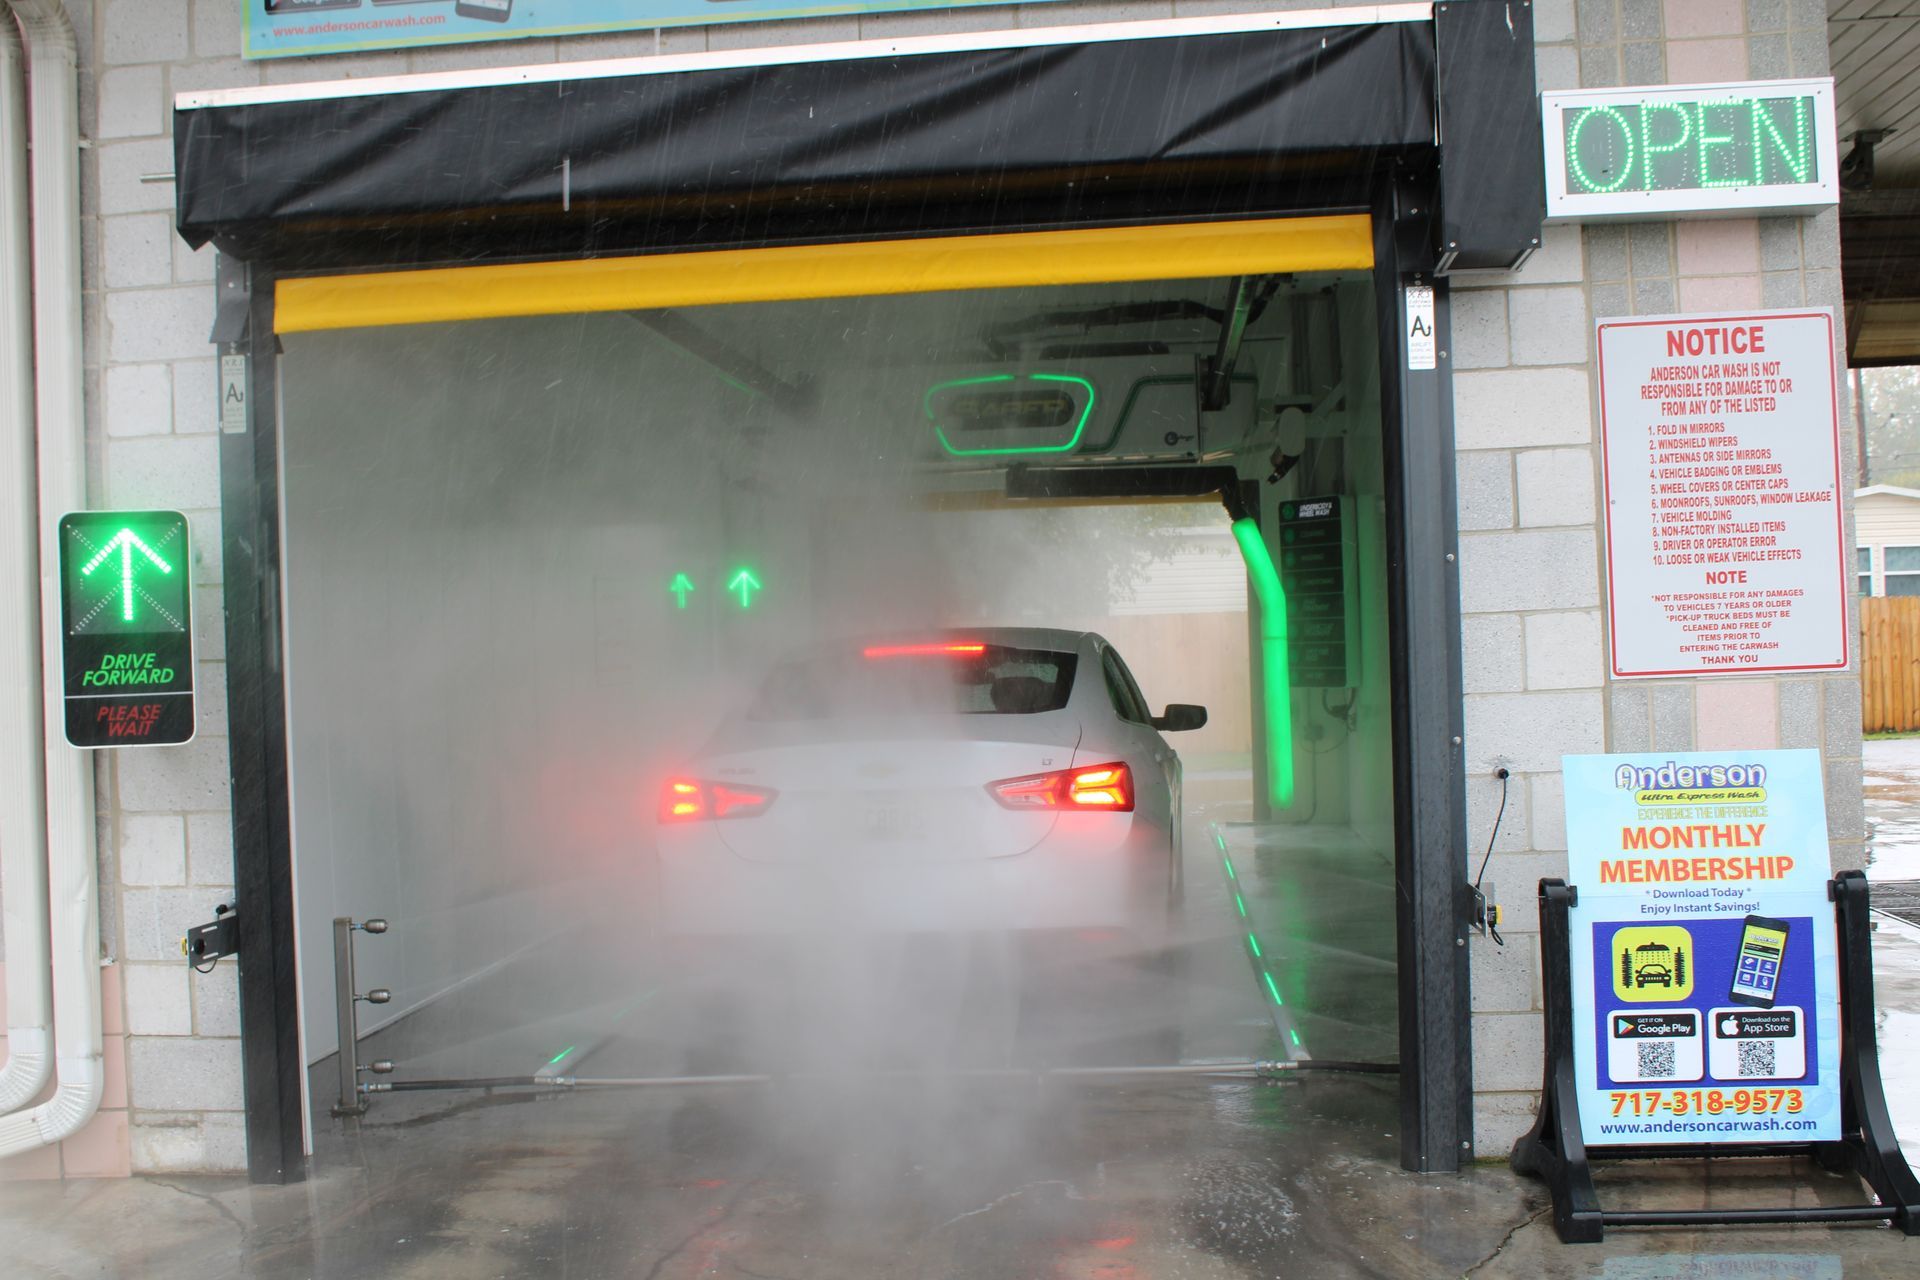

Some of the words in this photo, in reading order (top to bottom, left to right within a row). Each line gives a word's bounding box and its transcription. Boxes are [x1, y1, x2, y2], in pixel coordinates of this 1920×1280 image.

[273, 14, 445, 37] www.andersoncarwash.com
[1569, 96, 1807, 192] OPEN
[1666, 326, 1765, 357] NOTICE
[1650, 365, 1699, 381] ANDERSON
[1702, 365, 1720, 379] CAR
[1722, 363, 1748, 378] WASH
[1752, 363, 1760, 376] IS
[1763, 362, 1781, 376] NOT
[1641, 383, 1702, 400] RESPONSIBLE
[1705, 382, 1722, 396] FOR
[1725, 380, 1762, 396] DAMAGE
[1765, 380, 1777, 393] TO
[1779, 379, 1792, 393] OR
[1662, 401, 1687, 416] FROM
[1689, 400, 1706, 415] ANY
[1710, 400, 1722, 414] OF
[1724, 399, 1742, 413] THE
[1745, 397, 1776, 412] LISTED
[1648, 426, 1655, 436] 1.
[1657, 424, 1676, 435] FOLD
[1679, 424, 1687, 434] IN
[1690, 423, 1725, 434] MIRRORS
[1650, 440, 1656, 450] 2.
[1658, 438, 1706, 450] WINDSHIELD
[1708, 437, 1737, 448] WIPERS
[1650, 454, 1656, 464] 3.
[1659, 452, 1700, 464] ANTENNAS
[1703, 452, 1714, 462] OR
[1716, 451, 1734, 461] SIDE
[1736, 449, 1771, 460] MIRRORS
[1650, 469, 1657, 479] 4.
[1659, 467, 1692, 479] VEHICLE
[1694, 466, 1729, 478] BADGING
[1732, 466, 1743, 476] OR
[1745, 464, 1782, 475] EMBLEMS
[1651, 484, 1657, 494] 5.
[1660, 482, 1687, 494] WHEEL
[1689, 481, 1720, 493] COVERS
[1722, 481, 1733, 491] OR
[1735, 479, 1766, 491] CENTER
[1768, 478, 1788, 489] CAPS
[1651, 498, 1658, 509] 6.
[1660, 496, 1712, 509] MOONROOFS,
[1714, 494, 1758, 507] SUNROOFS,
[1760, 493, 1793, 504] WINDOW
[1795, 491, 1831, 502] LEAKAGE
[1652, 513, 1658, 523] 7.
[1661, 511, 1694, 523] VEHICLE
[1696, 510, 1732, 522] MOLDING
[1653, 527, 1659, 537] 8.
[1662, 524, 1715, 536] NON-FACTORY
[1718, 523, 1759, 534] INSTALLED
[1762, 521, 1786, 532] ITEMS
[1654, 541, 1660, 551] 9.
[1663, 540, 1691, 550] DRIVER
[1694, 539, 1704, 549] OR
[1707, 537, 1748, 549] OPERATOR
[1750, 536, 1776, 547] ERROR
[1654, 555, 1664, 566] 10.
[1667, 554, 1692, 565] LOOSE
[1695, 553, 1705, 564] OR
[1708, 552, 1729, 563] WEAK
[1733, 550, 1766, 562] VEHICLE
[1768, 549, 1801, 560] EFFECTS
[1706, 571, 1747, 584] NOTE
[1673, 592, 1727, 601] RESPONSIBLE
[1729, 591, 1745, 599] FOR
[1748, 590, 1764, 598] ANY
[1766, 589, 1804, 597] DAMAGES
[1664, 604, 1674, 612] TO
[1677, 603, 1715, 611] VEHICLES
[1766, 600, 1791, 608] OLDER
[1704, 613, 1730, 621] TRUCK
[1733, 612, 1753, 620] BEDS
[1680, 644, 1719, 652] ENTERING
[1740, 642, 1778, 650] CARWASH
[101, 653, 156, 669] DRIVE
[1701, 656, 1735, 665] THANK
[1738, 654, 1758, 663] YOU
[82, 668, 174, 686] FORWARD
[97, 704, 160, 721] PLEASE
[109, 721, 154, 736] WAIT
[1615, 761, 1767, 791] Anderson
[1641, 793, 1674, 801] Ultra
[1677, 792, 1724, 800] Express
[1728, 790, 1760, 798] Wash
[1638, 808, 1693, 820] EXPERIENCE
[1695, 807, 1712, 819] THE
[1714, 806, 1768, 818] DIFFERENCE
[1622, 824, 1766, 849] MONTHLY
[1600, 856, 1794, 883] MEMBERSHIP
[1653, 888, 1709, 899] Download
[1711, 888, 1743, 899] Today
[1641, 903, 1671, 915] Enjoy
[1674, 902, 1711, 912] Instant
[1714, 902, 1760, 912] Savings!
[1638, 1024, 1671, 1035] Google
[1673, 1024, 1690, 1034] Play
[1744, 1024, 1762, 1033] App
[1765, 1023, 1789, 1031] Store
[1611, 1089, 1803, 1117] 717-318-9573
[1601, 1119, 1817, 1134] www.andersoncarwash.com
